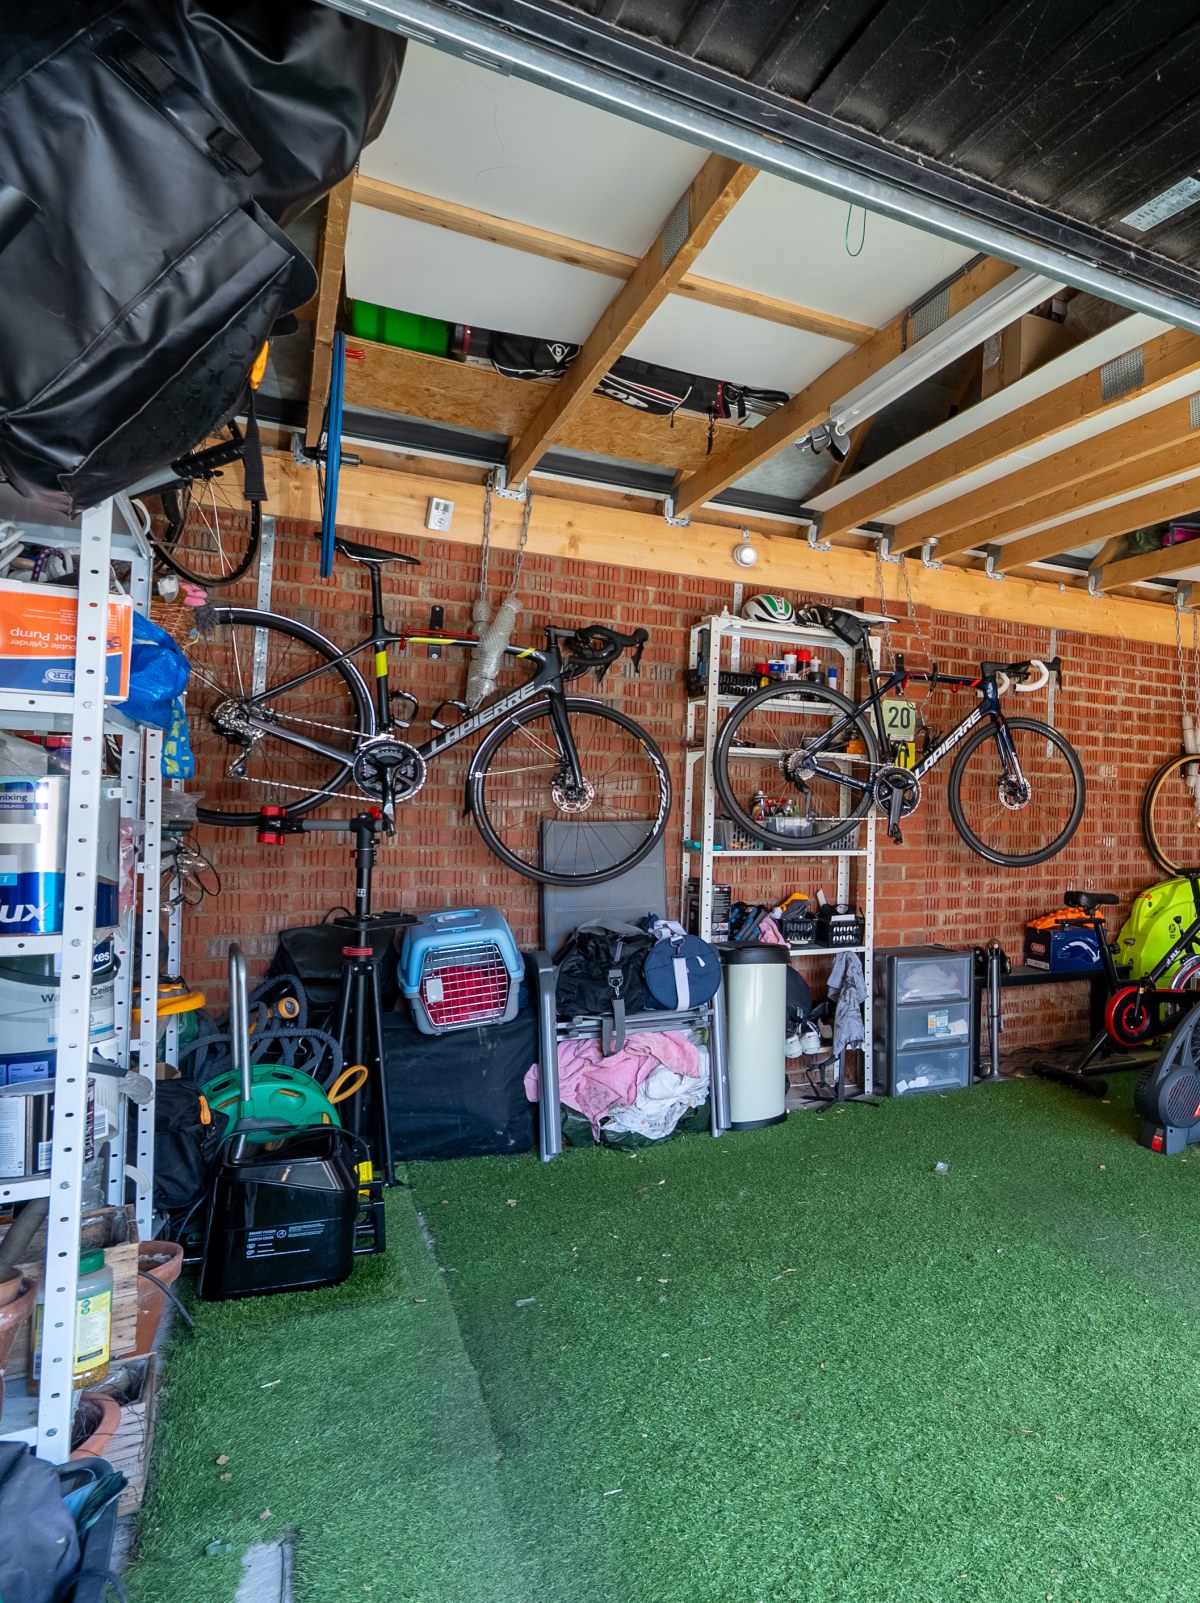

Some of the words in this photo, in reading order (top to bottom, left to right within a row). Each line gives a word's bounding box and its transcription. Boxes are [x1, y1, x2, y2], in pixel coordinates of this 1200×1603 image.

[10, 627, 50, 641] Pump
[54, 632, 76, 641] oot
[10, 638, 48, 650] Cylinder
[51, 642, 76, 650] ouble
[431, 681, 535, 753] LAPIERRE
[888, 706, 911, 729] 20
[915, 708, 981, 778] LAPIERRE
